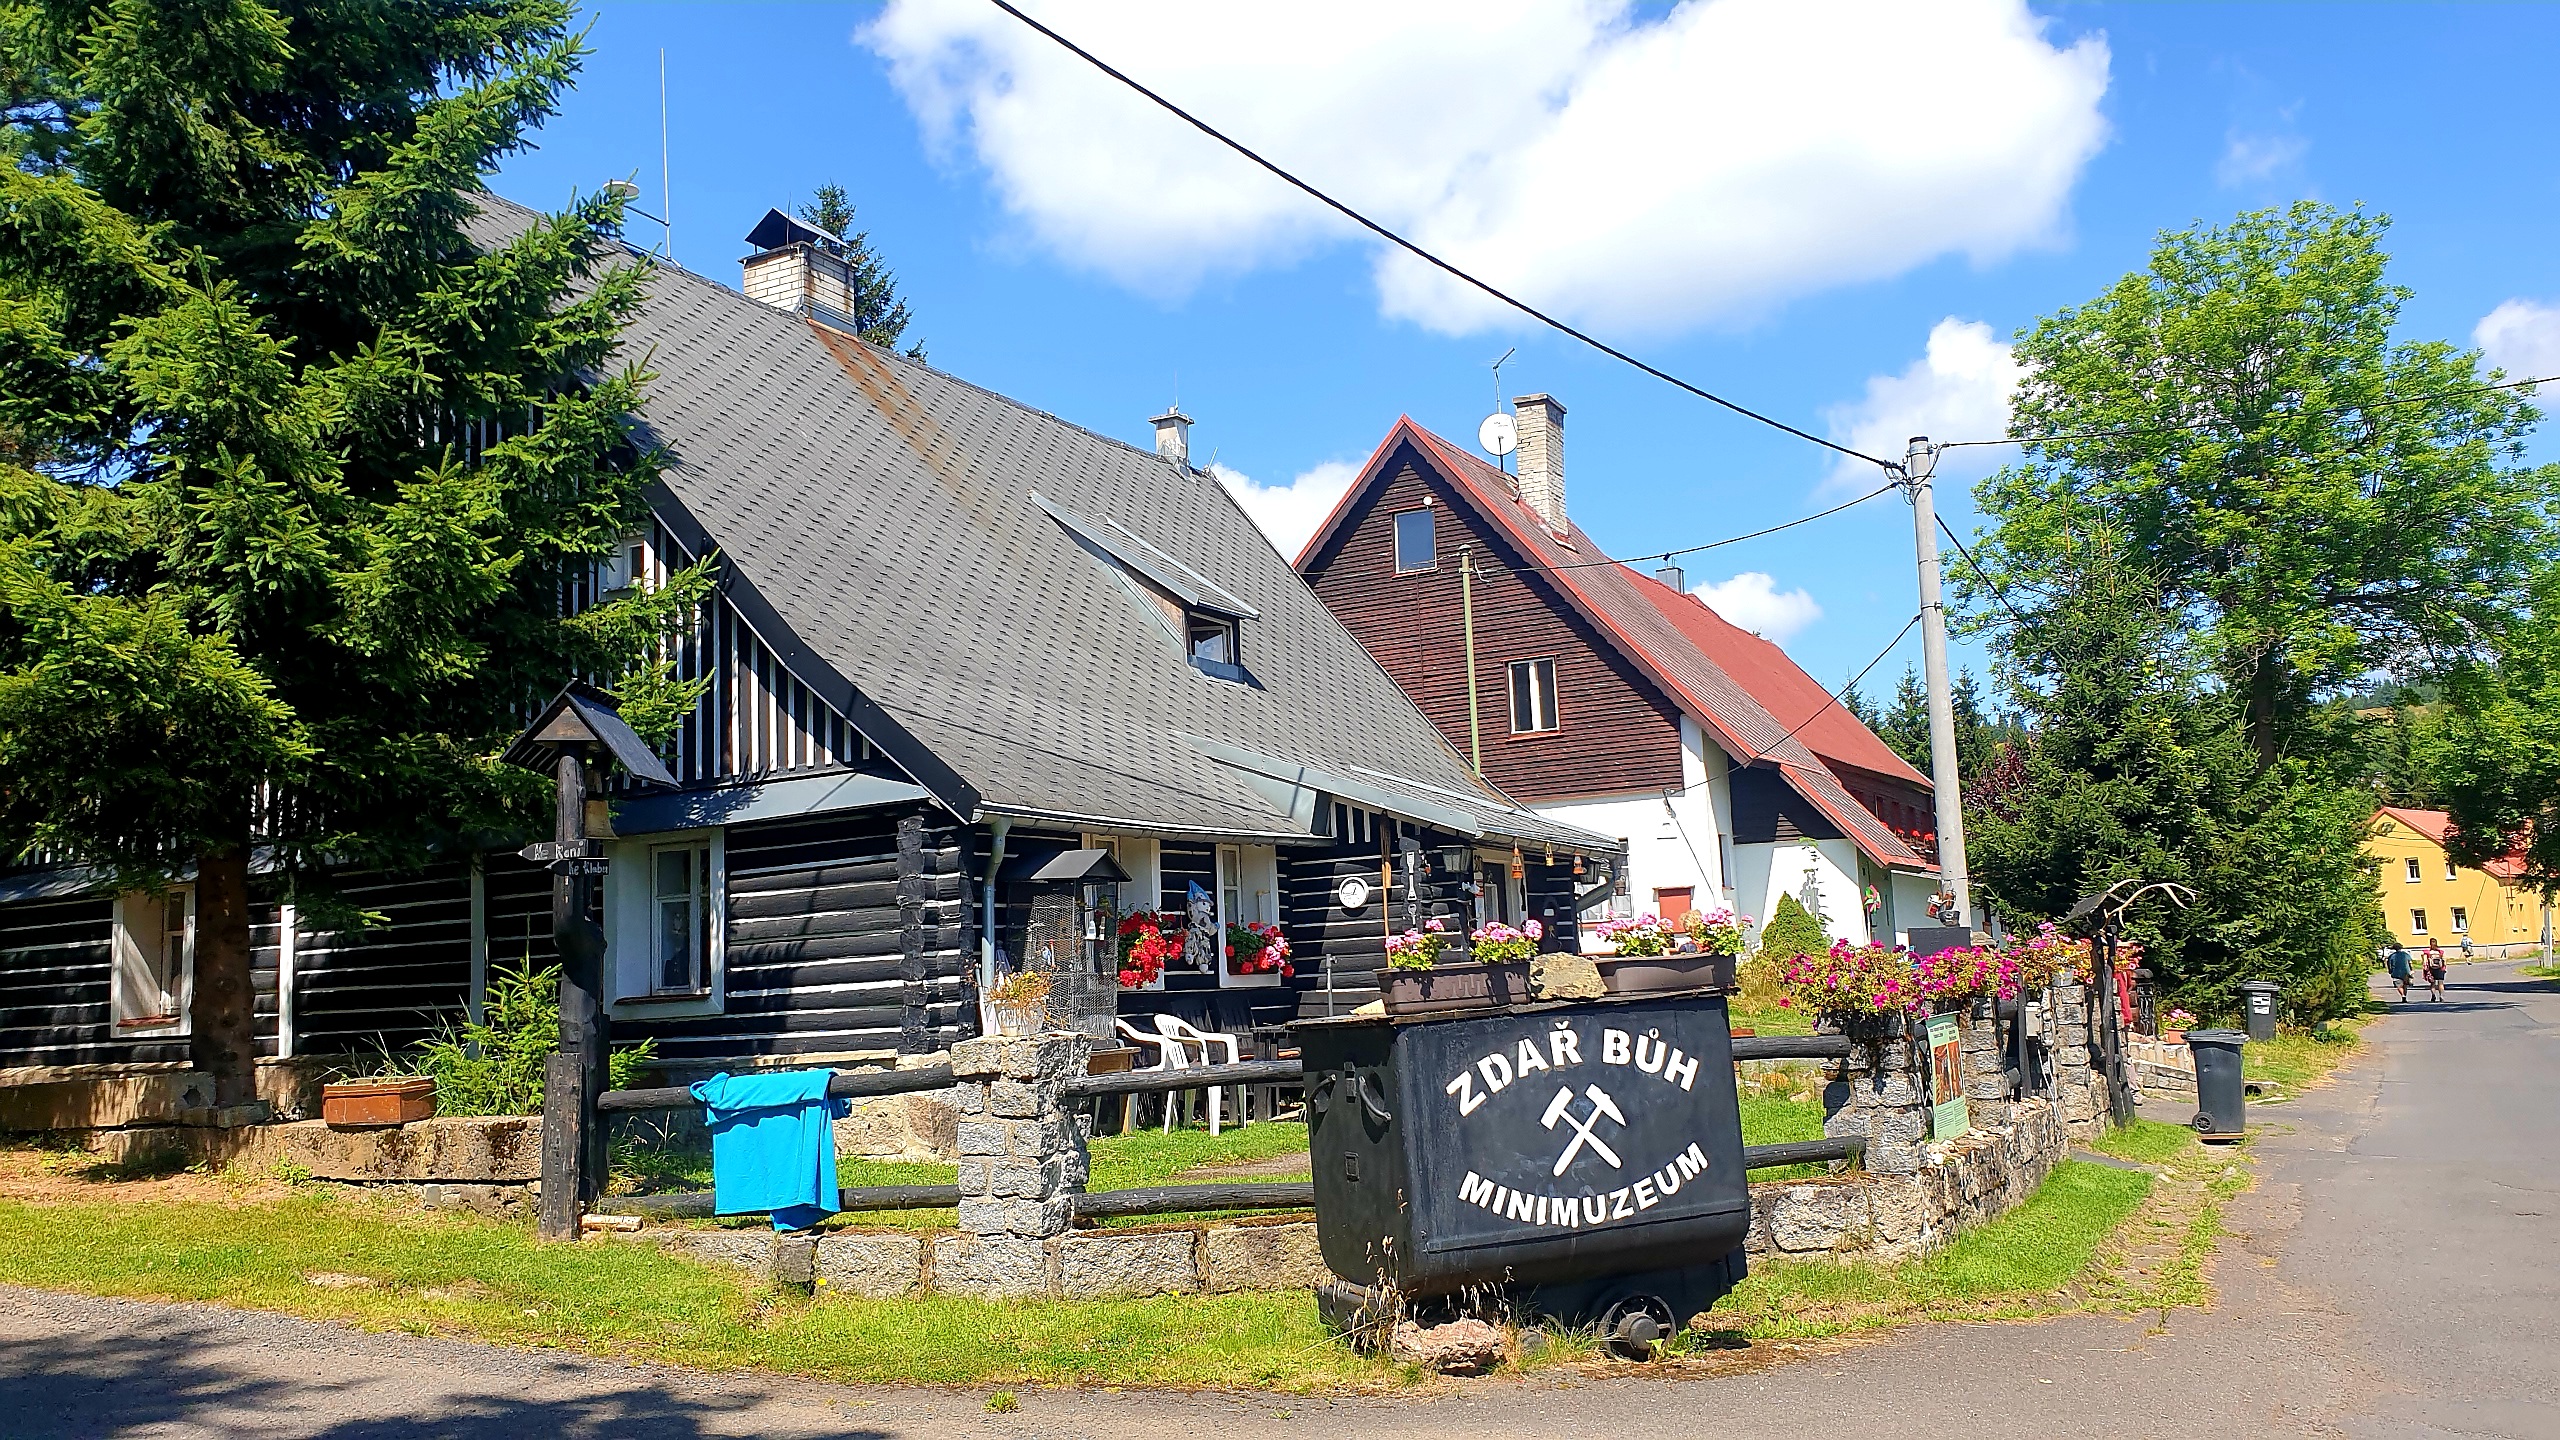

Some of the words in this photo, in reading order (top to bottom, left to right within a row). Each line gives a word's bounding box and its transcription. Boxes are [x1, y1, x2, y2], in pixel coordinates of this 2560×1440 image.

[1445, 1021, 1584, 1117] ZDAŘ
[1602, 1027, 1699, 1092] BŮH
[1457, 1142, 1709, 1229] MINIMUZEUM
